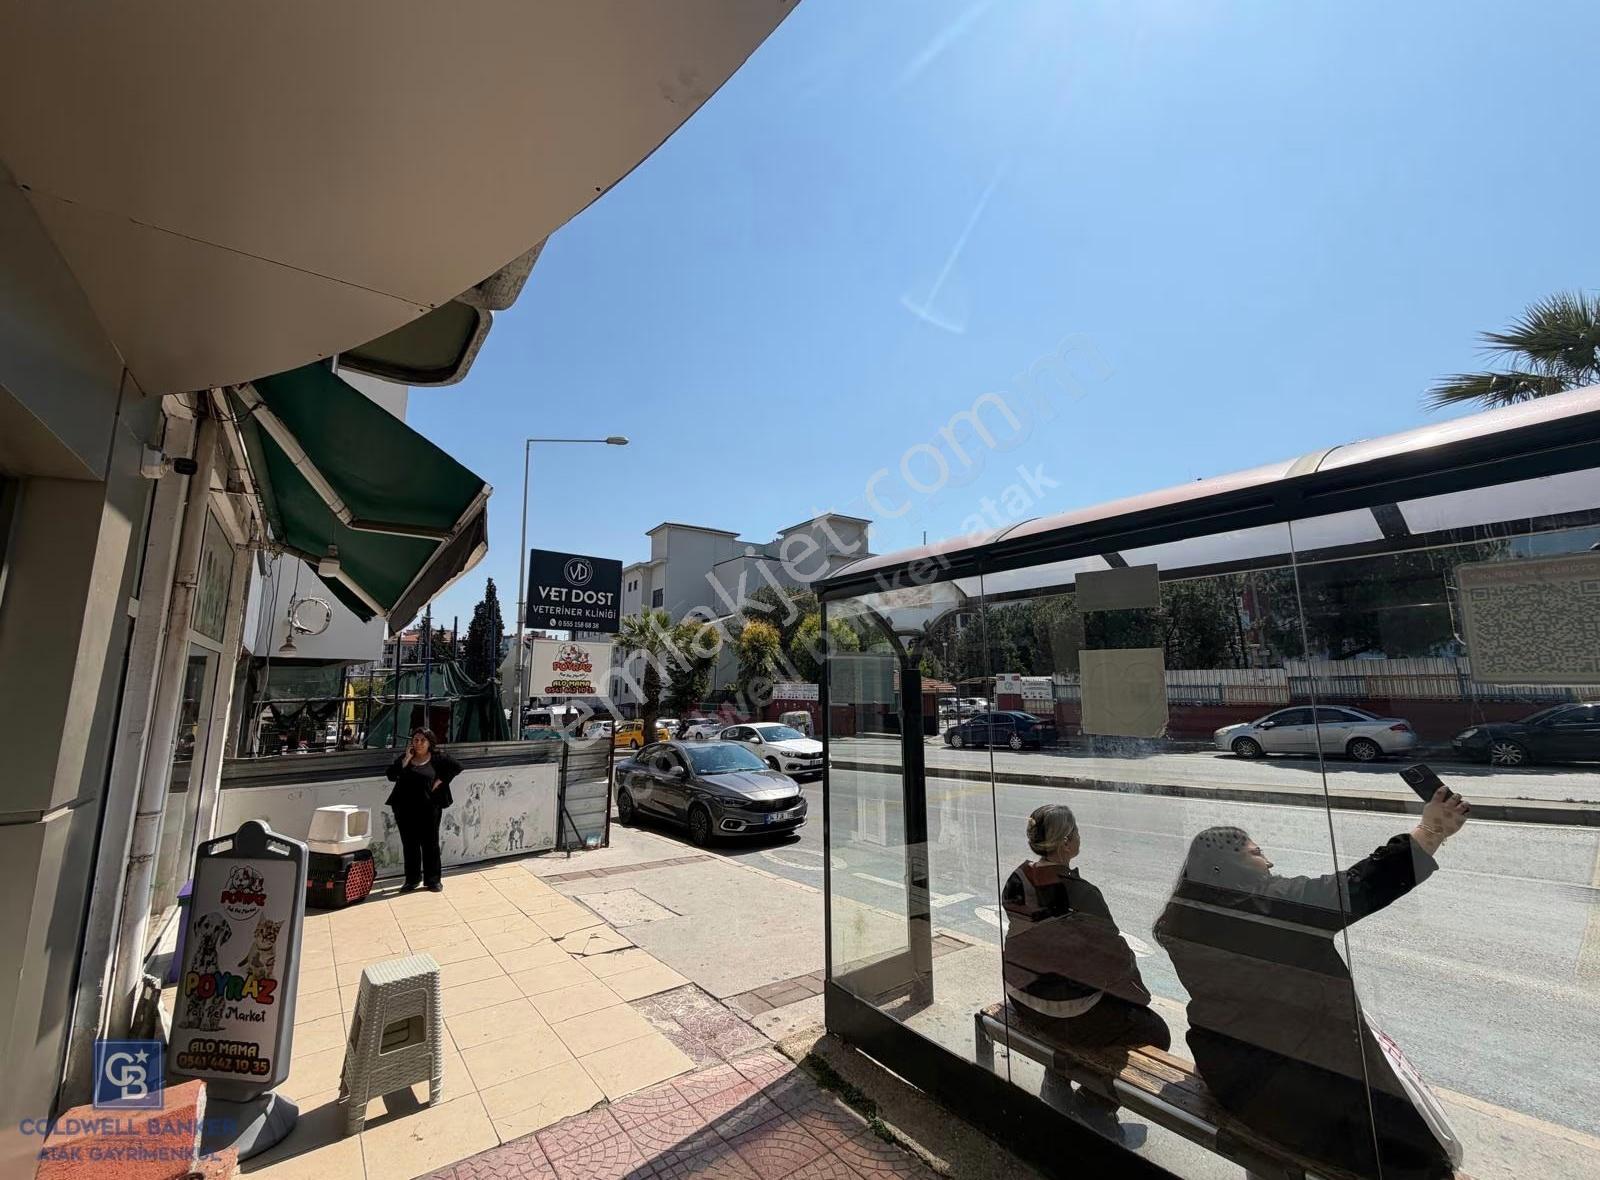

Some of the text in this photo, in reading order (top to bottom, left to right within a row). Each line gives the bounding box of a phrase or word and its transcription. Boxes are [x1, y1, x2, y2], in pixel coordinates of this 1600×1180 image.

[539, 585, 613, 605] VET DOST
[533, 604, 616, 619] VETERİNER KLİNİĞİ
[552, 662, 592, 672] POYRAZ
[185, 971, 277, 1005] POYRAZ
[225, 1007, 266, 1022] Market
[191, 1042, 256, 1057] ALO MAMA
[179, 1056, 207, 1066] 0541
[236, 1060, 249, 1070] 10
[253, 1062, 267, 1072] 35
